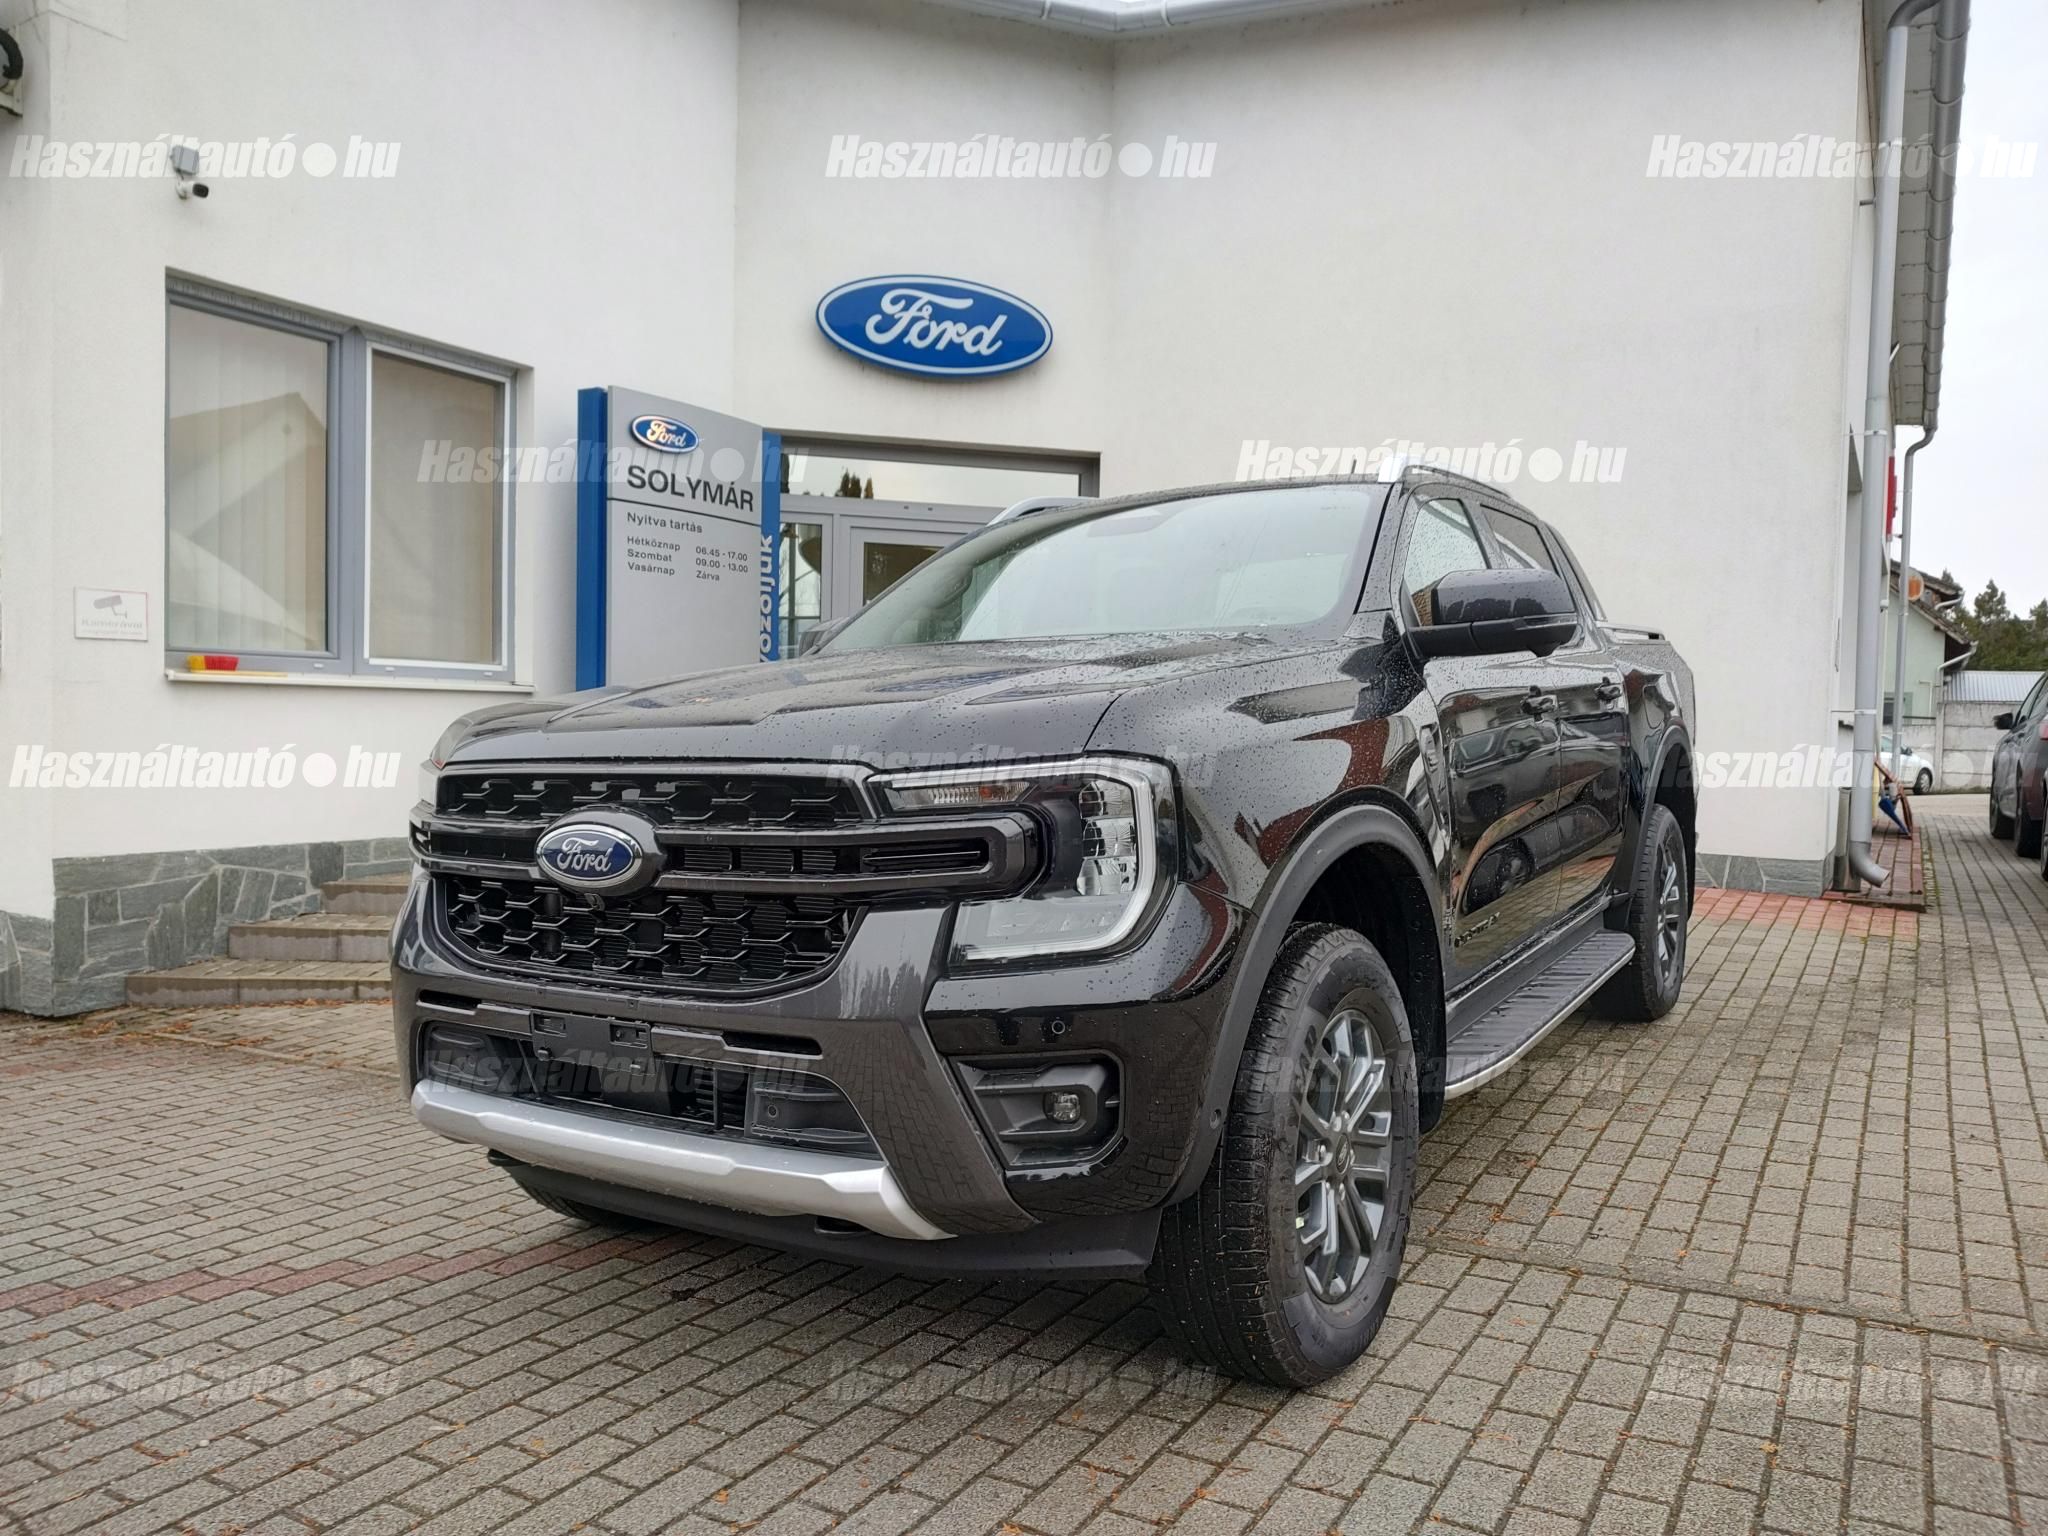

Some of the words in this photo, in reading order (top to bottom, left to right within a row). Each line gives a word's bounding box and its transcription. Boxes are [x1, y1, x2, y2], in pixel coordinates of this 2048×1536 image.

[865, 288, 1007, 356] Ford
[646, 419, 686, 448] Ford
[627, 465, 754, 512] SOLYMÁR
[627, 512, 667, 528] Nyitva
[670, 519, 703, 534] tartás
[627, 536, 681, 552] Hétköznap
[695, 546, 720, 557] 06.45
[727, 551, 748, 562] 17.00
[627, 549, 673, 562] Szombat
[695, 557, 721, 569] 09.00
[727, 563, 748, 573] 13.00
[627, 562, 675, 576] Vasárnap
[696, 570, 720, 581] Zárva
[557, 837, 613, 872] Ford
